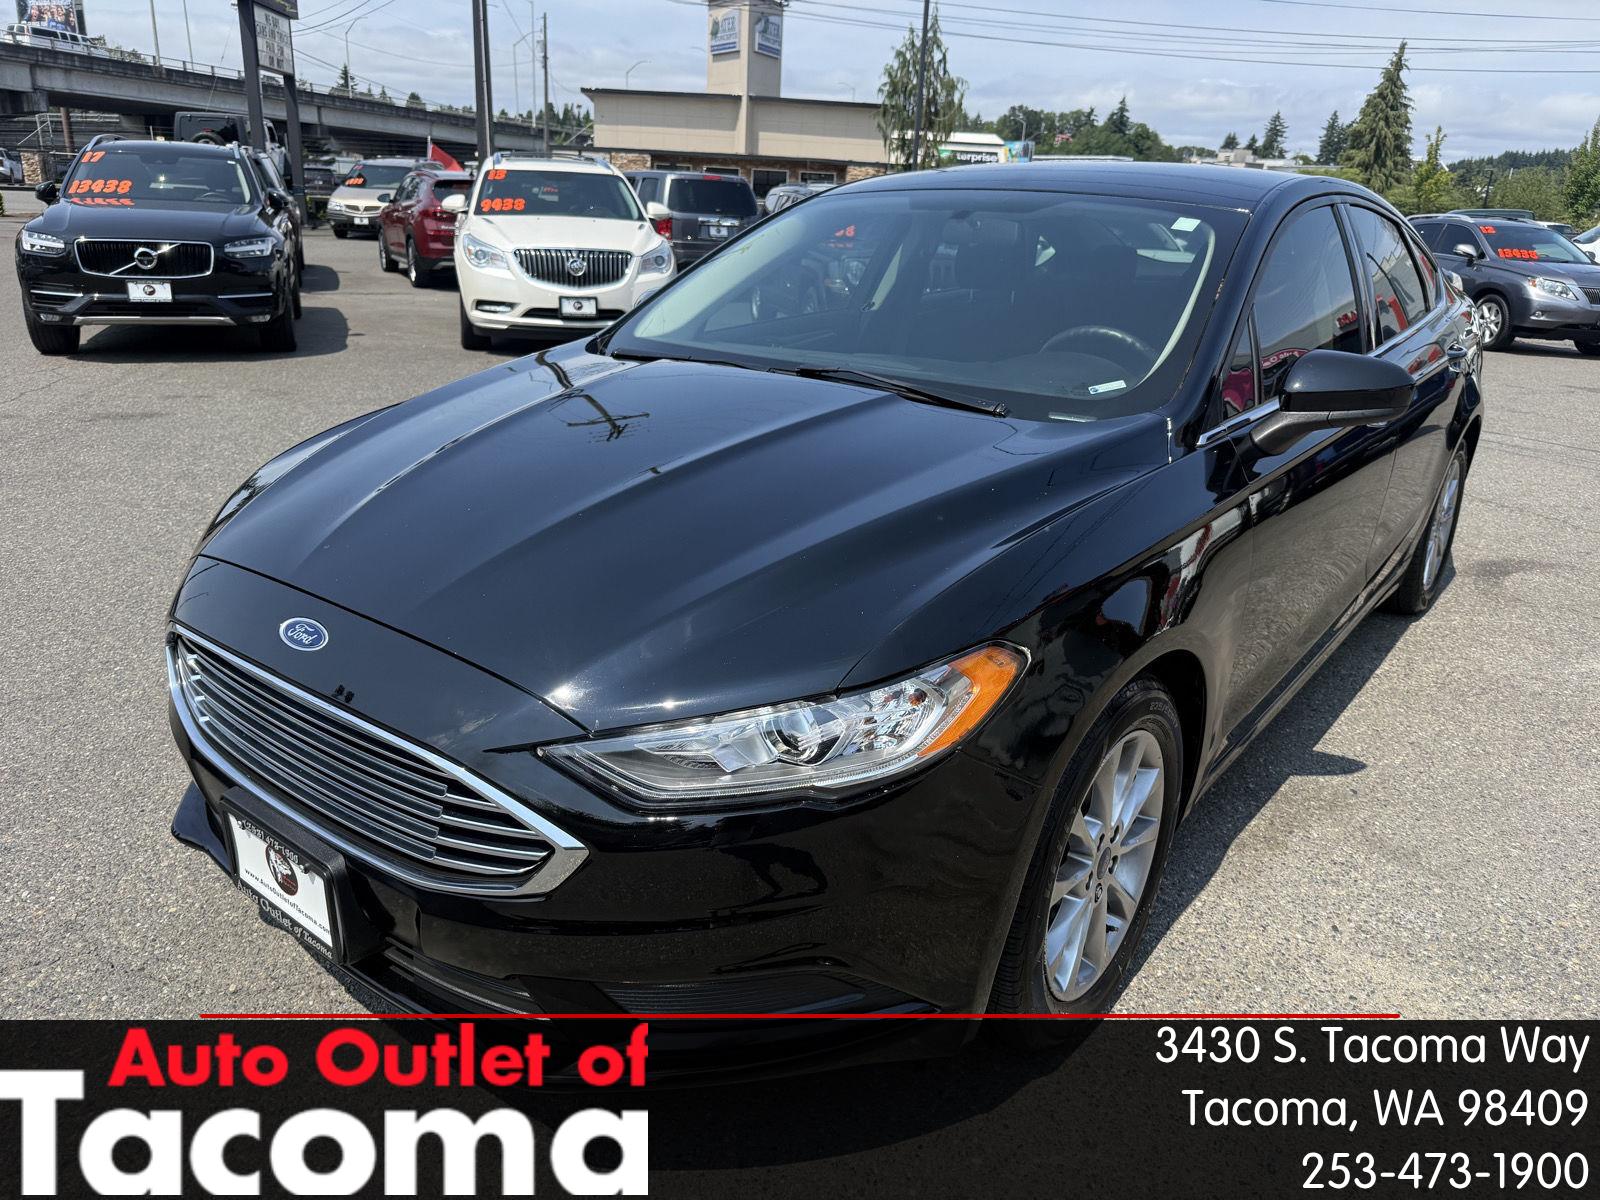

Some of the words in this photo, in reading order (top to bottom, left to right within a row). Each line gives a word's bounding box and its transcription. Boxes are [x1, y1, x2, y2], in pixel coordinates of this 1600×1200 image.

[81, 151, 106, 163] 17
[68, 179, 133, 194] 13438
[480, 198, 526, 212] 9438
[287, 623, 318, 645] Ford
[236, 879, 259, 904] Auto
[260, 897, 294, 931] Outlet
[302, 930, 333, 960] Tacoma
